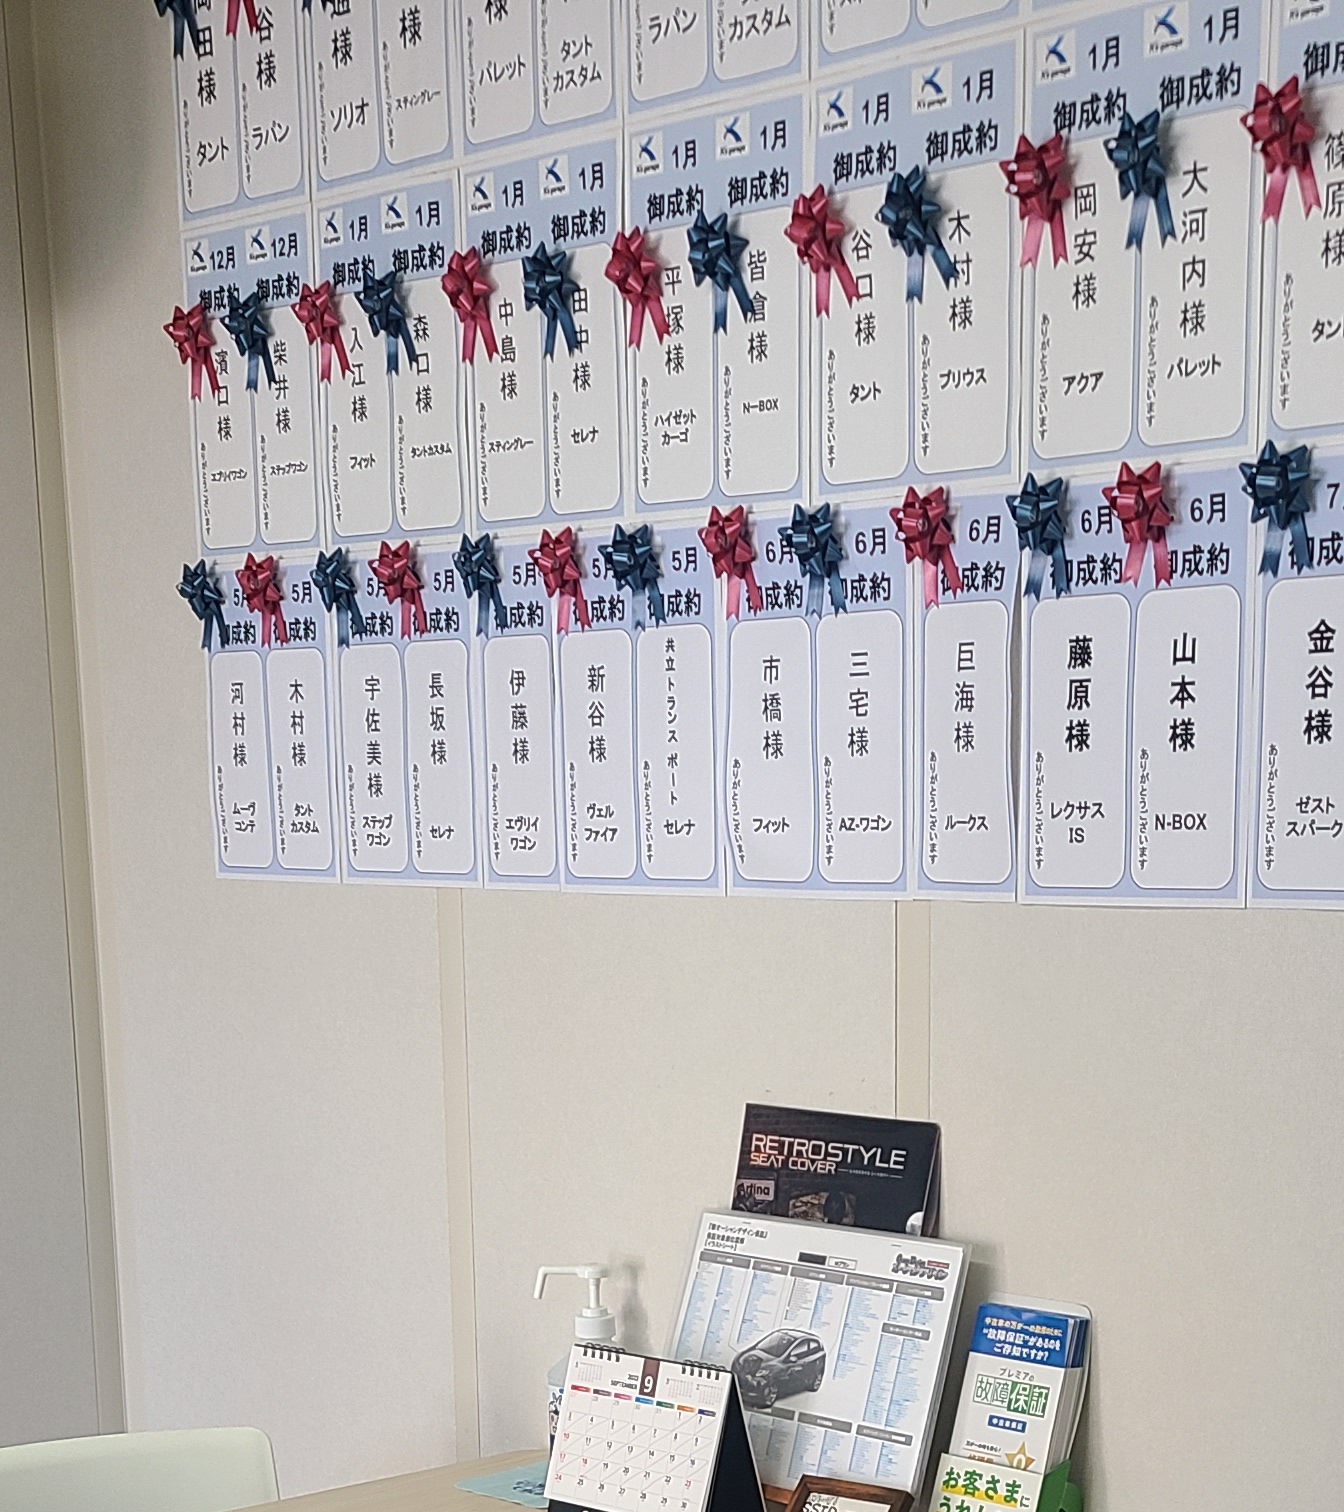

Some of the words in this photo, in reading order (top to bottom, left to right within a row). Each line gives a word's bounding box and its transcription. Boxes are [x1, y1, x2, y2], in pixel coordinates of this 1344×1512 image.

[648, 5, 698, 45] ラパン
[727, 2, 792, 44] カスタム
[1202, 5, 1240, 46] 1月
[559, 34, 594, 64] タント
[1087, 34, 1121, 74] 1月
[478, 53, 527, 87] パレット
[552, 60, 603, 95] カスタム
[961, 67, 995, 105] 1月
[1158, 59, 1242, 114] 御成約
[329, 96, 370, 133] ソリオ
[196, 135, 230, 168] タント
[251, 119, 290, 151] ラパン
[924, 117, 999, 167] 御成約
[210, 246, 235, 271] 12月
[271, 233, 298, 258] 12月
[1071, 181, 1098, 312] 岡安様
[1178, 159, 1209, 340] 大河内様
[852, 229, 876, 347] 谷口様
[948, 211, 974, 332] 木村様
[413, 314, 433, 414] 森口様
[498, 298, 517, 401] 中島様
[1166, 352, 1222, 380] パレット
[350, 327, 368, 423] 入江様
[848, 380, 882, 405] タント
[1061, 370, 1105, 397] アクア
[570, 425, 600, 445] セレナ
[1080, 505, 1113, 534] 6月
[1189, 491, 1226, 527] 6月
[856, 527, 889, 555] 6月
[968, 515, 1002, 544] 6月
[434, 569, 455, 592] 5月
[671, 551, 699, 574] 5月
[292, 581, 313, 603] 5月
[949, 641, 977, 754] 巨海様
[1064, 634, 1094, 754] 藤原様
[1168, 631, 1197, 753] 山本様
[1302, 618, 1337, 746] 金谷様
[288, 678, 308, 767] 木村様
[428, 672, 449, 766] 長坂様
[508, 668, 531, 765] 伊藤様
[586, 663, 608, 764] 新谷様
[760, 654, 784, 760] 市橋様
[847, 651, 871, 758] 三宅様
[230, 681, 248, 768] 河村様
[364, 674, 387, 800] 宇佐美様
[944, 813, 989, 832] ルークス
[1050, 800, 1106, 821] レクサス
[1154, 812, 1208, 832] N-BOX
[1265, 744, 1278, 871] ありがとうございます
[1294, 794, 1336, 816] ゼスト
[428, 824, 455, 840] セレナ
[662, 818, 696, 836] セレナ
[752, 816, 791, 834] フィット
[838, 814, 893, 833] AZ-ワゴン
[1068, 826, 1085, 844] IS
[1285, 818, 1344, 839] スパーク
[509, 834, 537, 852] ワゴン
[750, 1152, 785, 1168] SEAT
[788, 1157, 836, 1174] COVER
[751, 1133, 907, 1169] RETROSTYLE
[644, 1376, 654, 1392] 9
[974, 1377, 1049, 1416] 故障保証
[942, 1466, 1031, 1508] お客さまに
